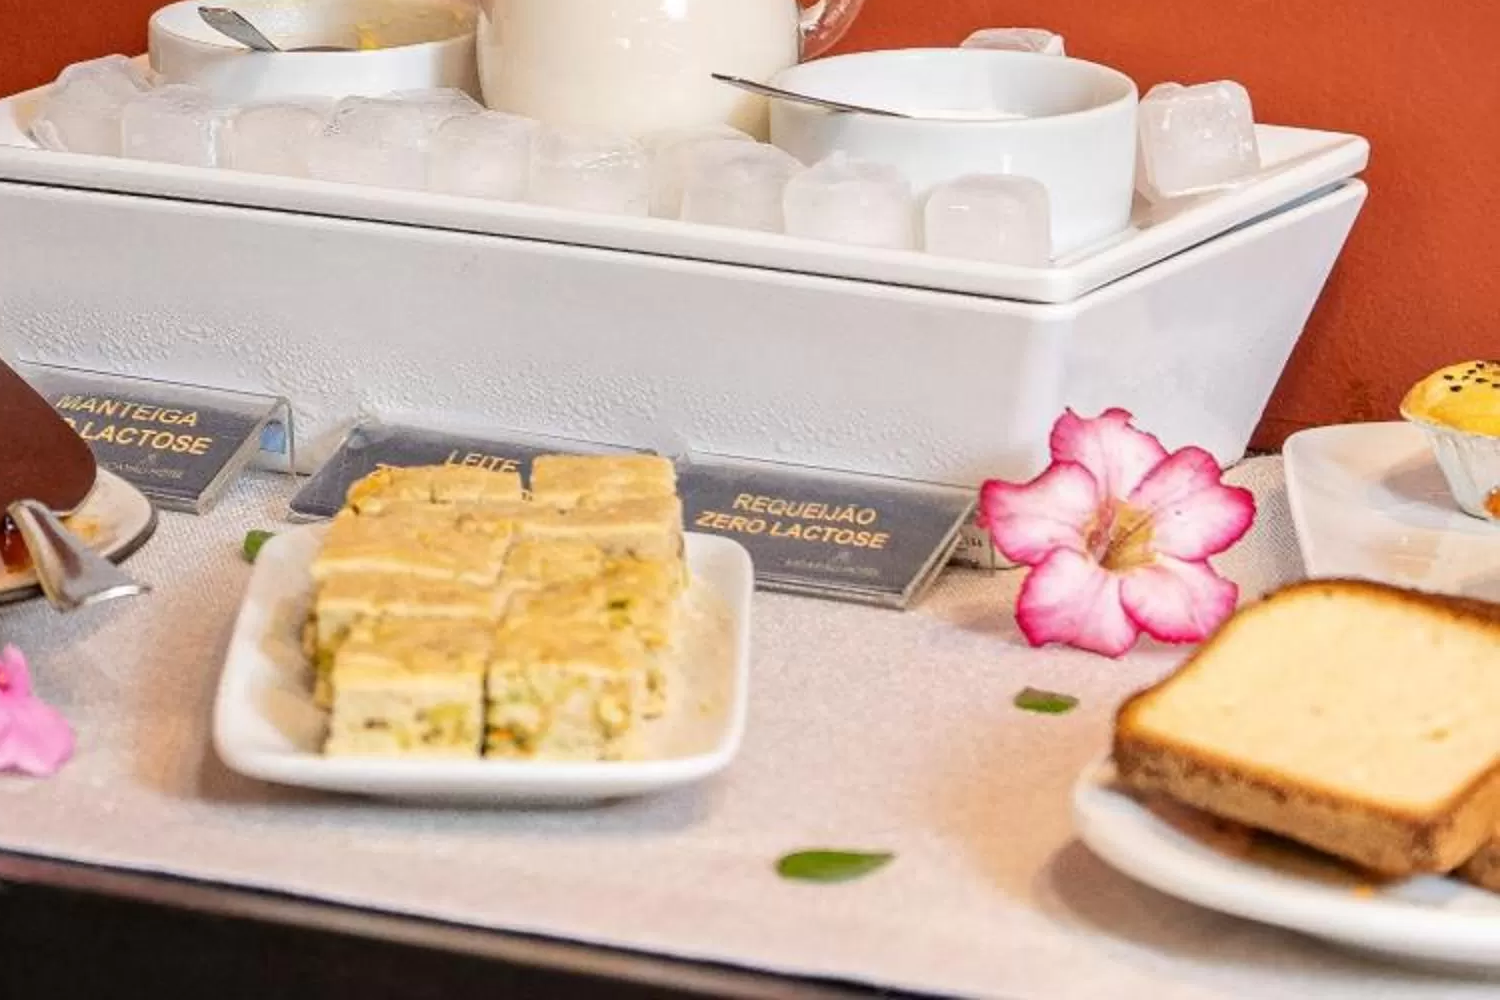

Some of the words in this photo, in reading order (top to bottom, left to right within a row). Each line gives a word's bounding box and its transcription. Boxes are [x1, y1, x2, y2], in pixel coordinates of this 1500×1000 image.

[56, 395, 199, 428] MANTEIGA
[80, 421, 213, 456] LACTOSE
[445, 449, 521, 473] LEITE
[732, 492, 877, 526] REQUEIJÃO
[695, 511, 767, 534] ZERO
[769, 520, 891, 549] LACTOSE
